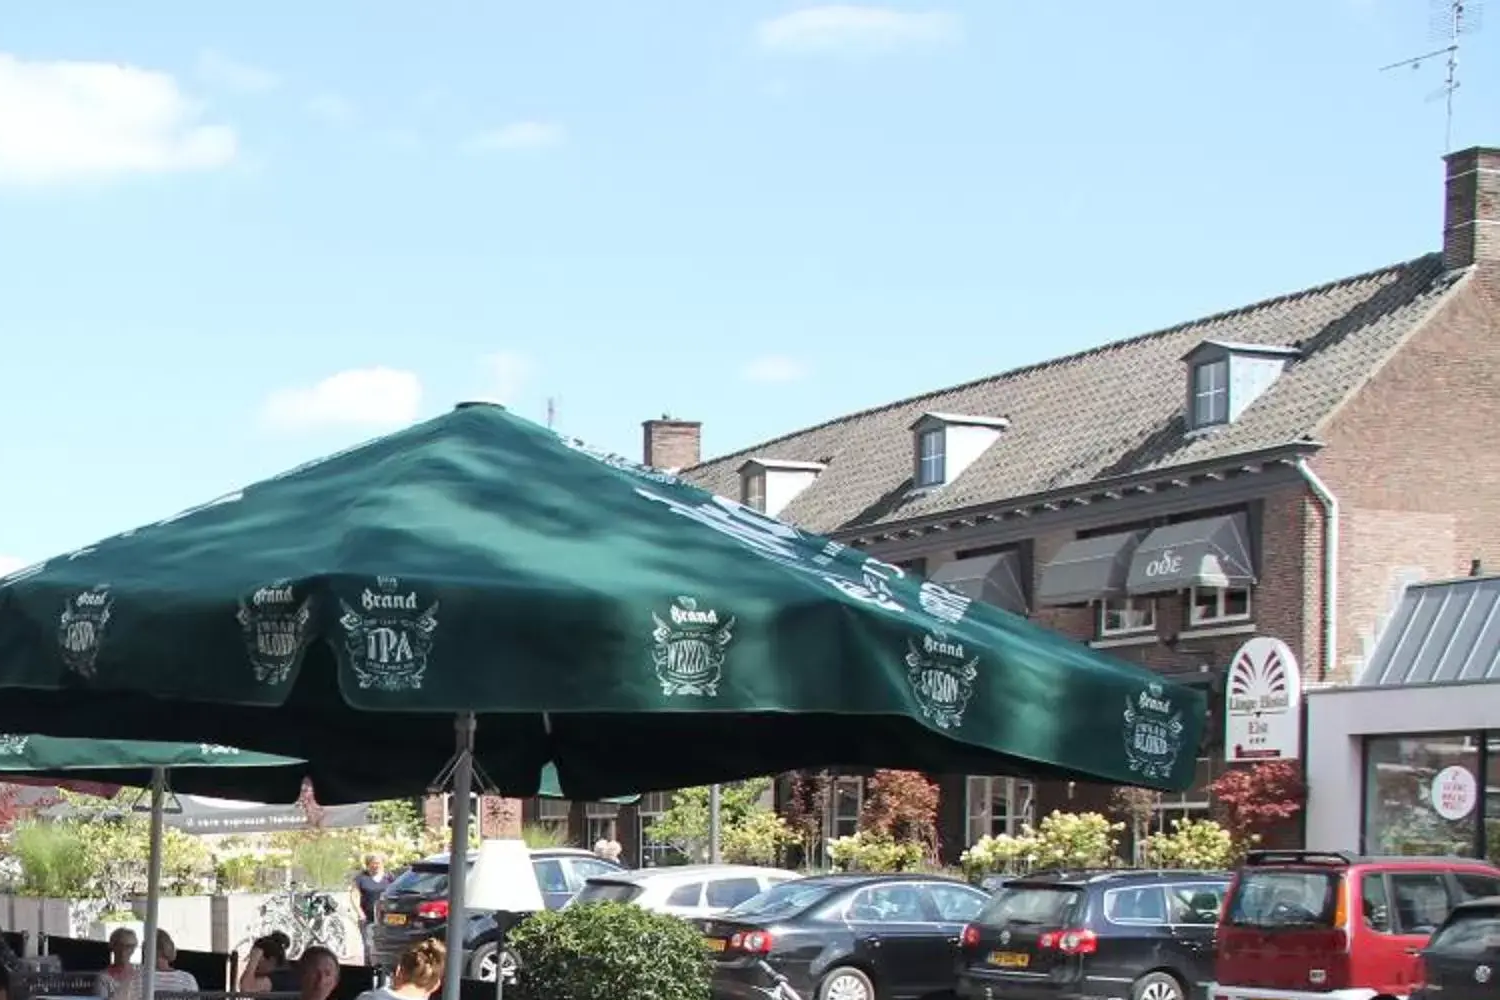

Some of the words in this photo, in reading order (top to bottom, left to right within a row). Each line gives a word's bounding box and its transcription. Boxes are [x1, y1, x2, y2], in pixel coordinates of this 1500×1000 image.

[361, 588, 417, 611] Brand
[670, 604, 718, 626] Brand
[367, 628, 414, 663] IPA
[923, 634, 965, 659] Brand
[921, 669, 959, 703] SAISON
